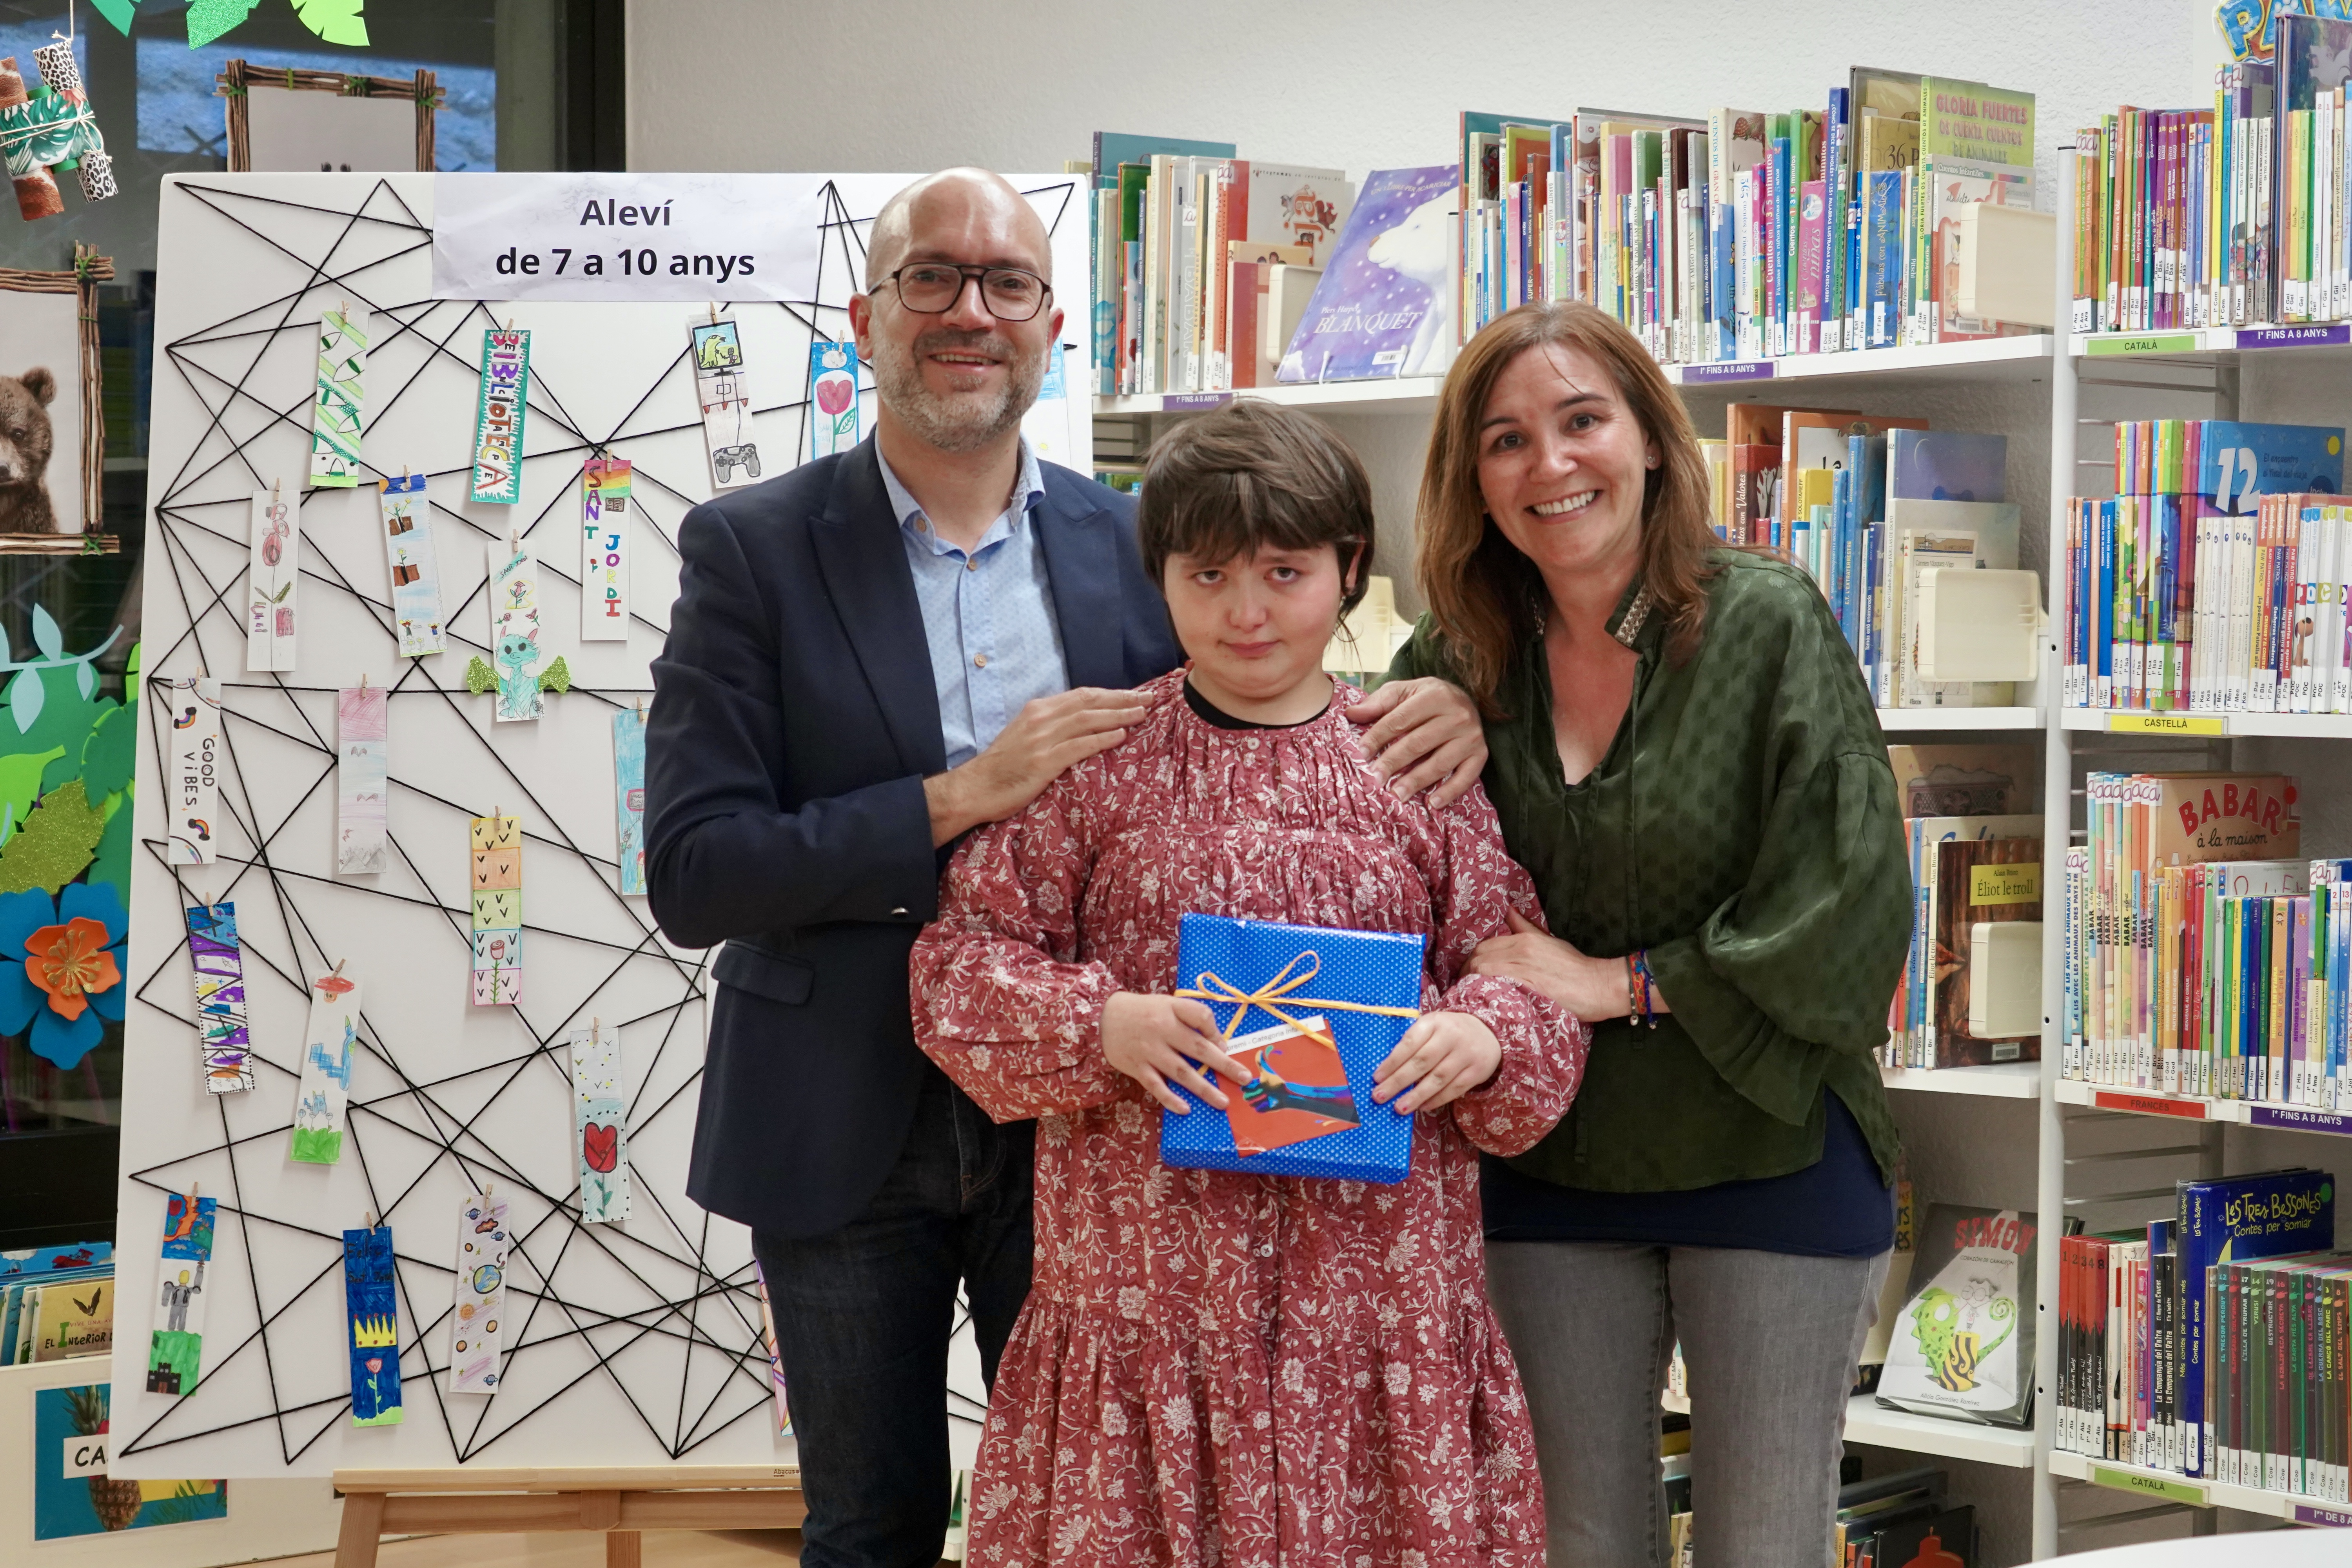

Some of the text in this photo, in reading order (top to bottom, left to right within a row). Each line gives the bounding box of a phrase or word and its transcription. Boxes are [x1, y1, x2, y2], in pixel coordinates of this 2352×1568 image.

[1936, 93, 2027, 125] GLORIA FUERTES
[1940, 118, 2023, 146] OS CUENTA CUENTOS
[1887, 143, 1905, 169] 36
[1938, 163, 1984, 178] Cuentos Infantiles
[580, 199, 674, 226] Aleví
[1768, 230, 1773, 238] en
[496, 247, 754, 283] de 7 a 10 anys
[1314, 312, 1423, 334] BLANQUET
[2266, 330, 2285, 339] FINS
[2288, 330, 2294, 338] A
[2297, 330, 2301, 338] 8
[2303, 328, 2327, 338] ANYS
[2125, 339, 2157, 350] CATALÀ
[475, 333, 519, 490] BIBLIOTECA
[2264, 453, 2269, 462] El
[2216, 447, 2260, 514] 12
[1736, 474, 1746, 508] Valores
[585, 466, 602, 539] SANT
[605, 535, 621, 616] JORDI
[2145, 719, 2187, 728] CASTELLÀ
[201, 738, 215, 786] GOOD
[2178, 782, 2282, 839] BABAR
[2197, 828, 2267, 848] à la maison
[1977, 879, 2033, 897] Éliot le troll
[1252, 1031, 1284, 1044] Categoria
[1286, 1024, 1308, 1034] Infal
[2280, 1111, 2300, 1121] FINS
[2302, 1112, 2308, 1121] A
[2310, 1113, 2316, 1122] 8
[2318, 1113, 2342, 1125] ANYS
[2235, 1219, 2312, 1237] Contes per somiar
[2063, 1251, 2067, 1261] 1
[2072, 1254, 2078, 1264] 2
[2088, 1258, 2094, 1268] 4
[2098, 1259, 2105, 1269] 8
[45, 1339, 55, 1348] EL
[1935, 1395, 1959, 1403] González
[74, 1445, 108, 1466] CA
[2132, 1477, 2165, 1491] CATALÀ
[2326, 1512, 2337, 1522] DE
[2340, 1515, 2345, 1523] 8
